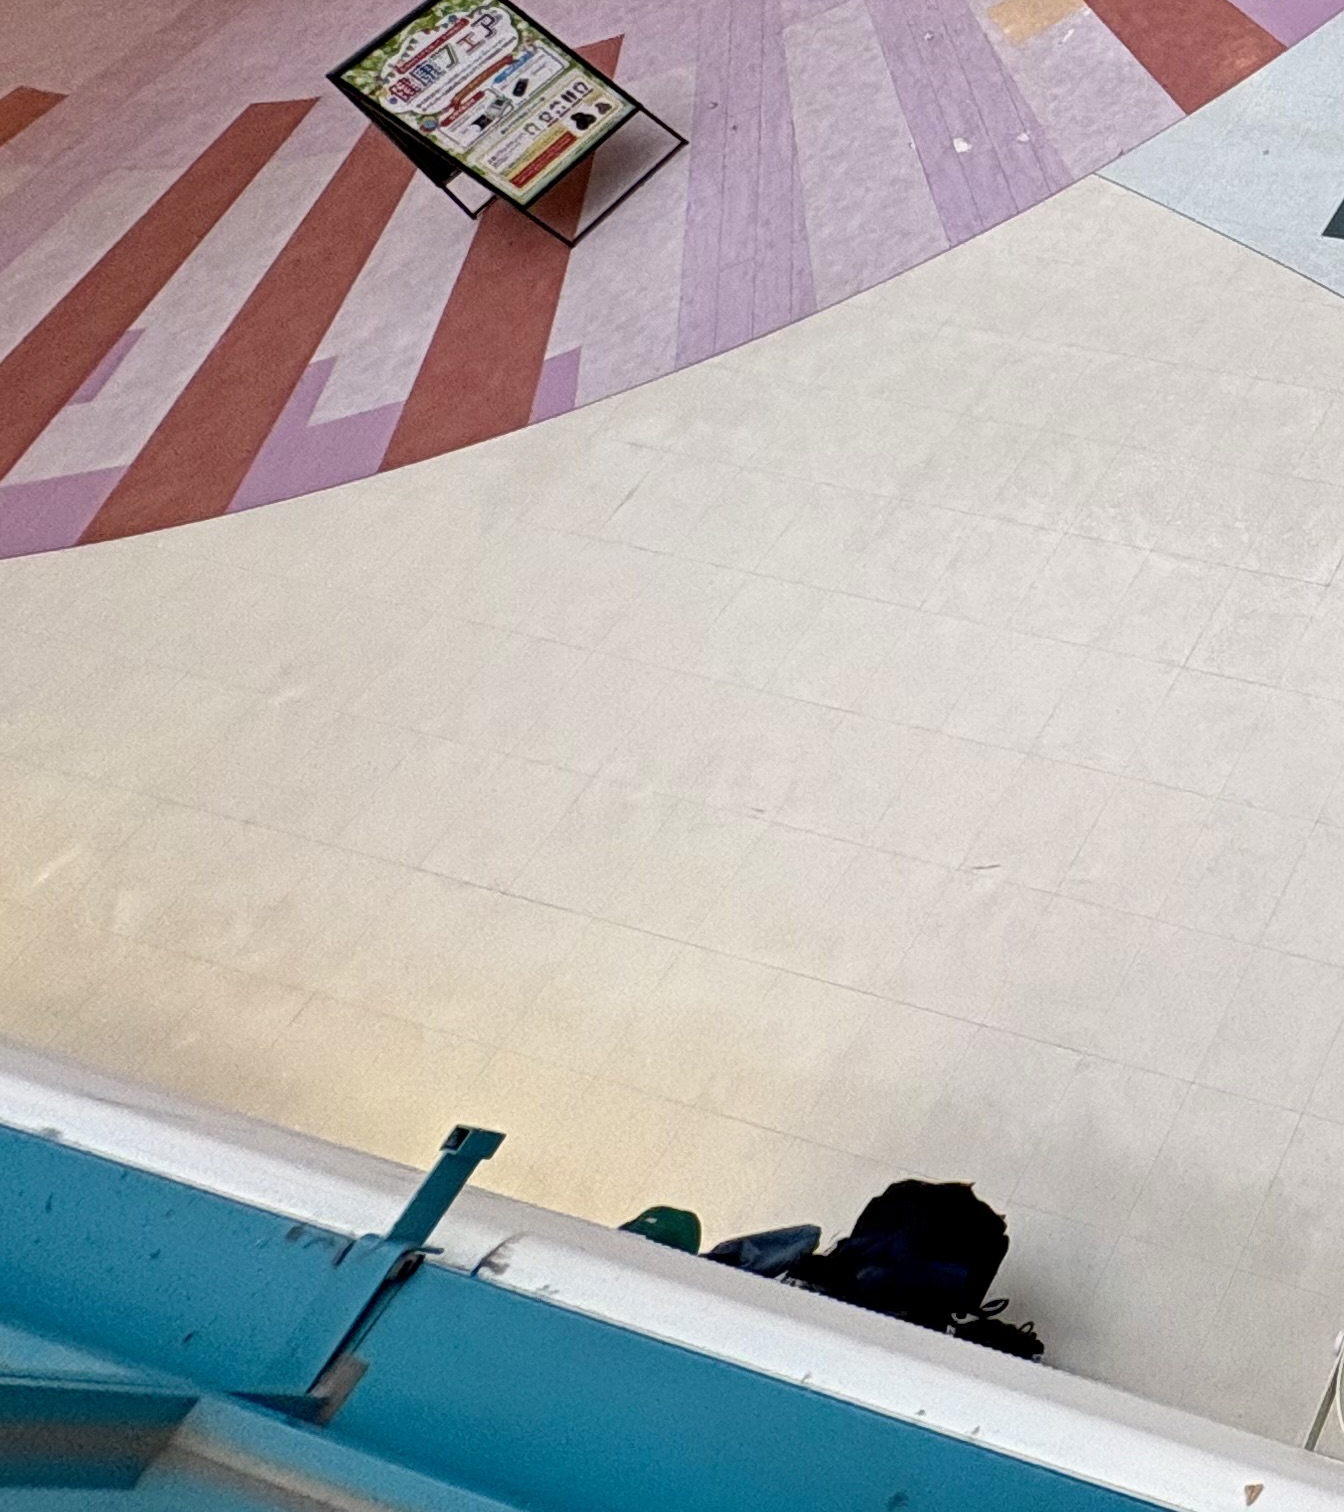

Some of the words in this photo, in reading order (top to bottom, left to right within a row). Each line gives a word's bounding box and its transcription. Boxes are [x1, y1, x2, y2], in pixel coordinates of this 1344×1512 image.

[388, 12, 501, 104] 健康フェア
